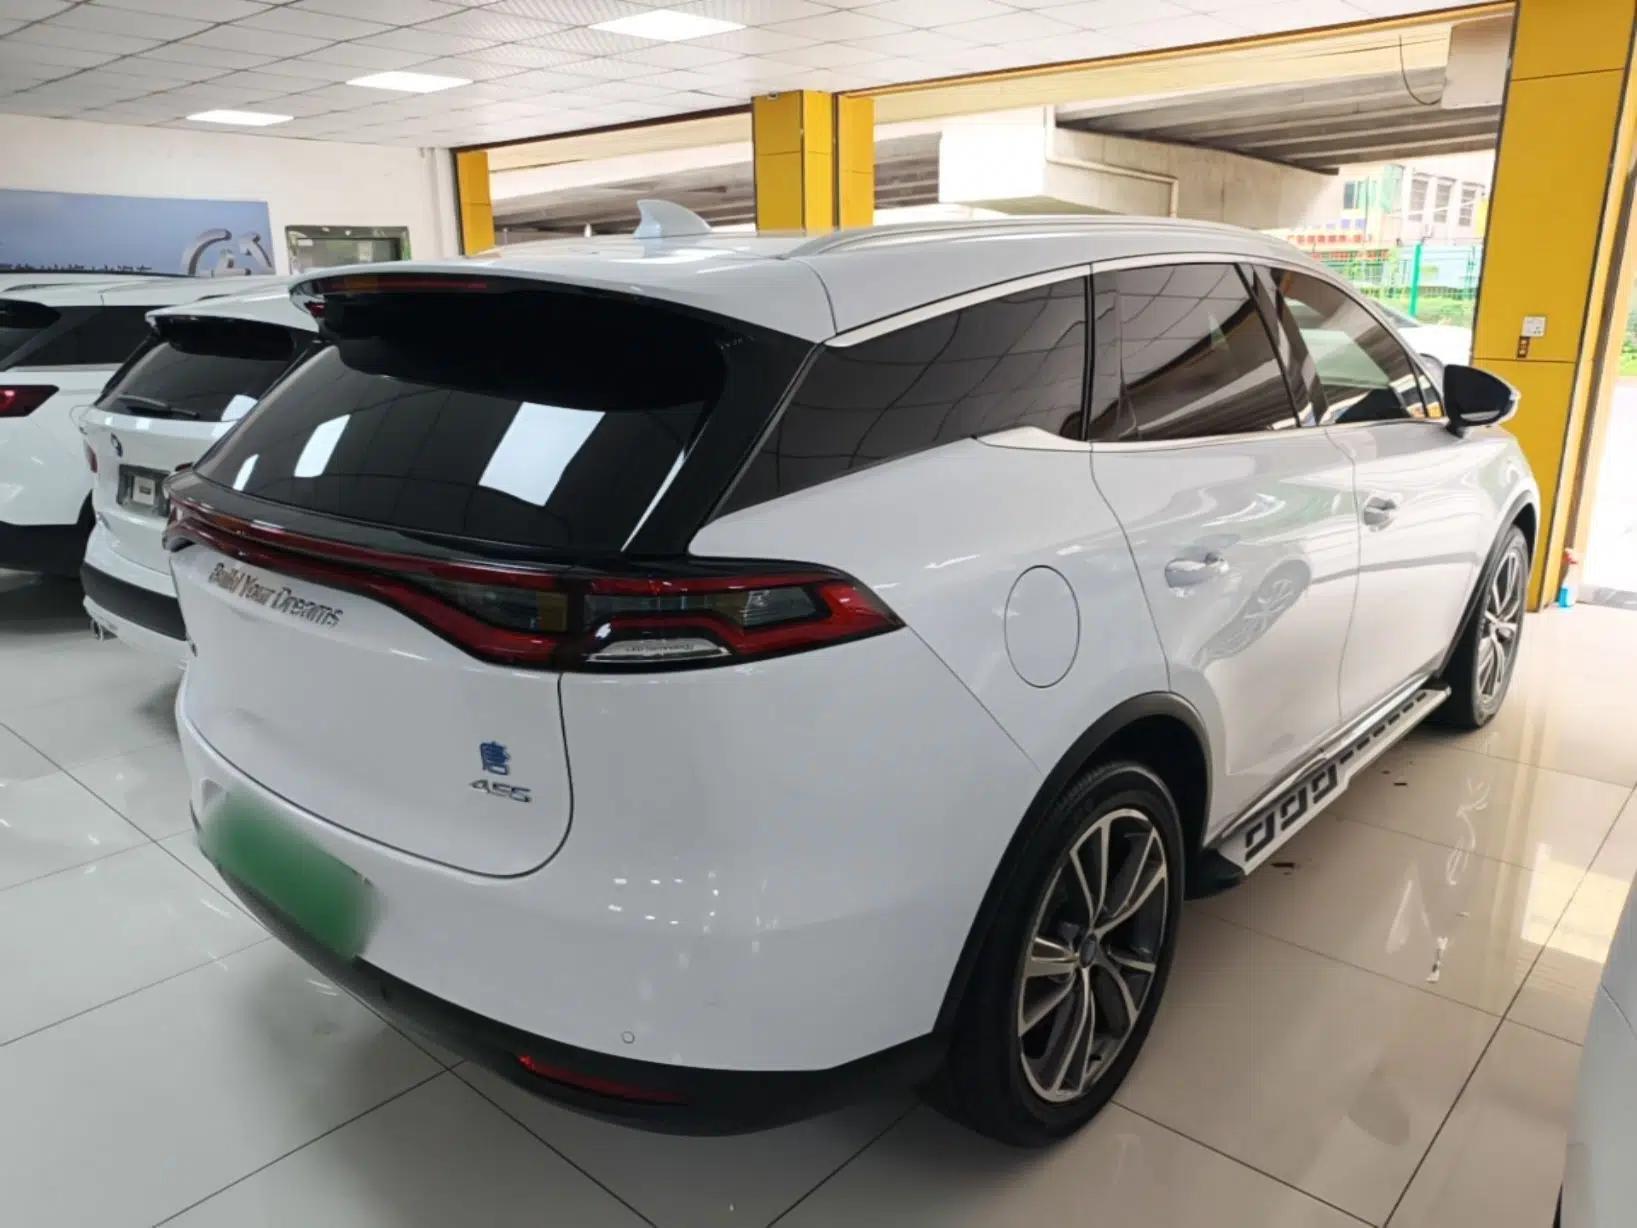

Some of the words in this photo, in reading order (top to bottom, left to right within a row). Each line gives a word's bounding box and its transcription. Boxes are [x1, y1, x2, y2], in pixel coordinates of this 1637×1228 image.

[208, 561, 246, 594] Build
[239, 574, 276, 606] Your
[271, 586, 344, 627] Dreams
